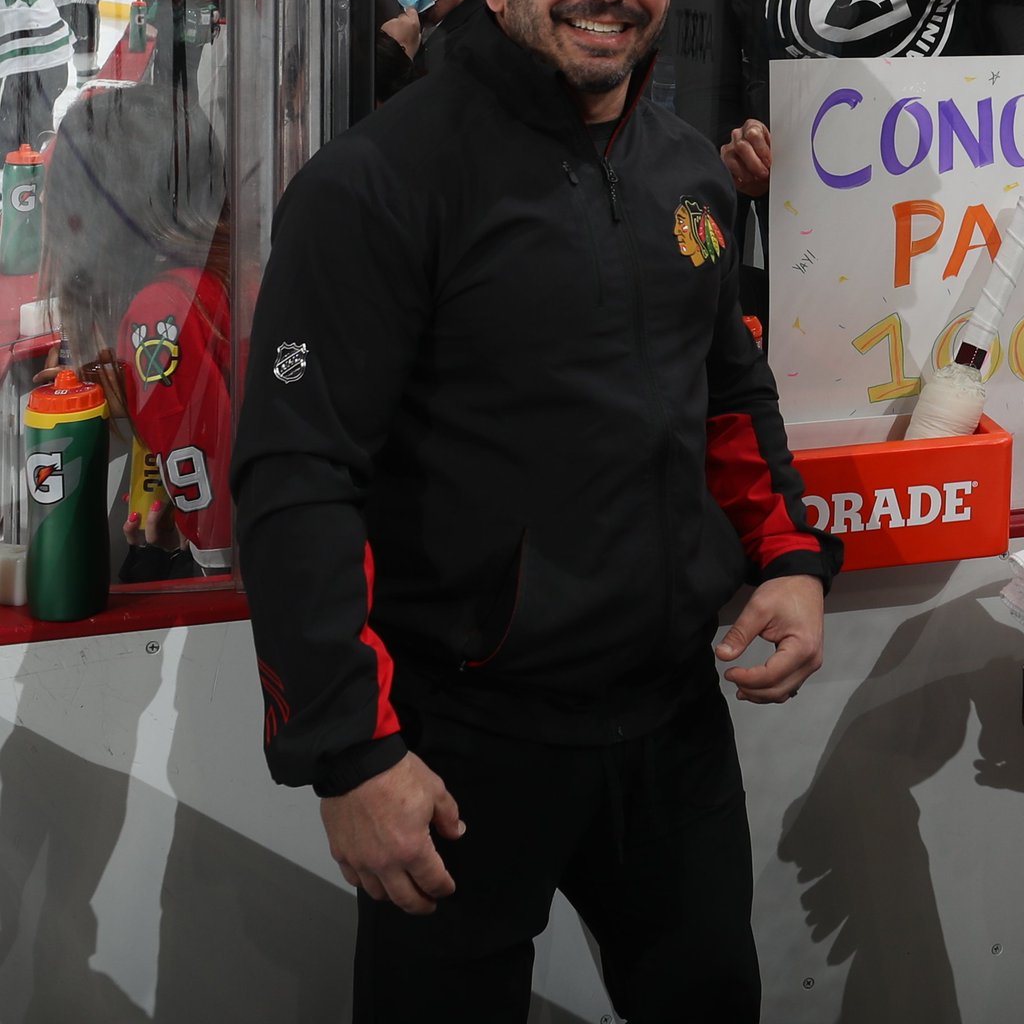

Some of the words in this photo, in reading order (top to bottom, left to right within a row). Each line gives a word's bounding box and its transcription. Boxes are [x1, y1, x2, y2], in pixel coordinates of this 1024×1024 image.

[10, 183, 36, 212] G
[791, 249, 816, 274] YAY!
[26, 451, 65, 505] G
